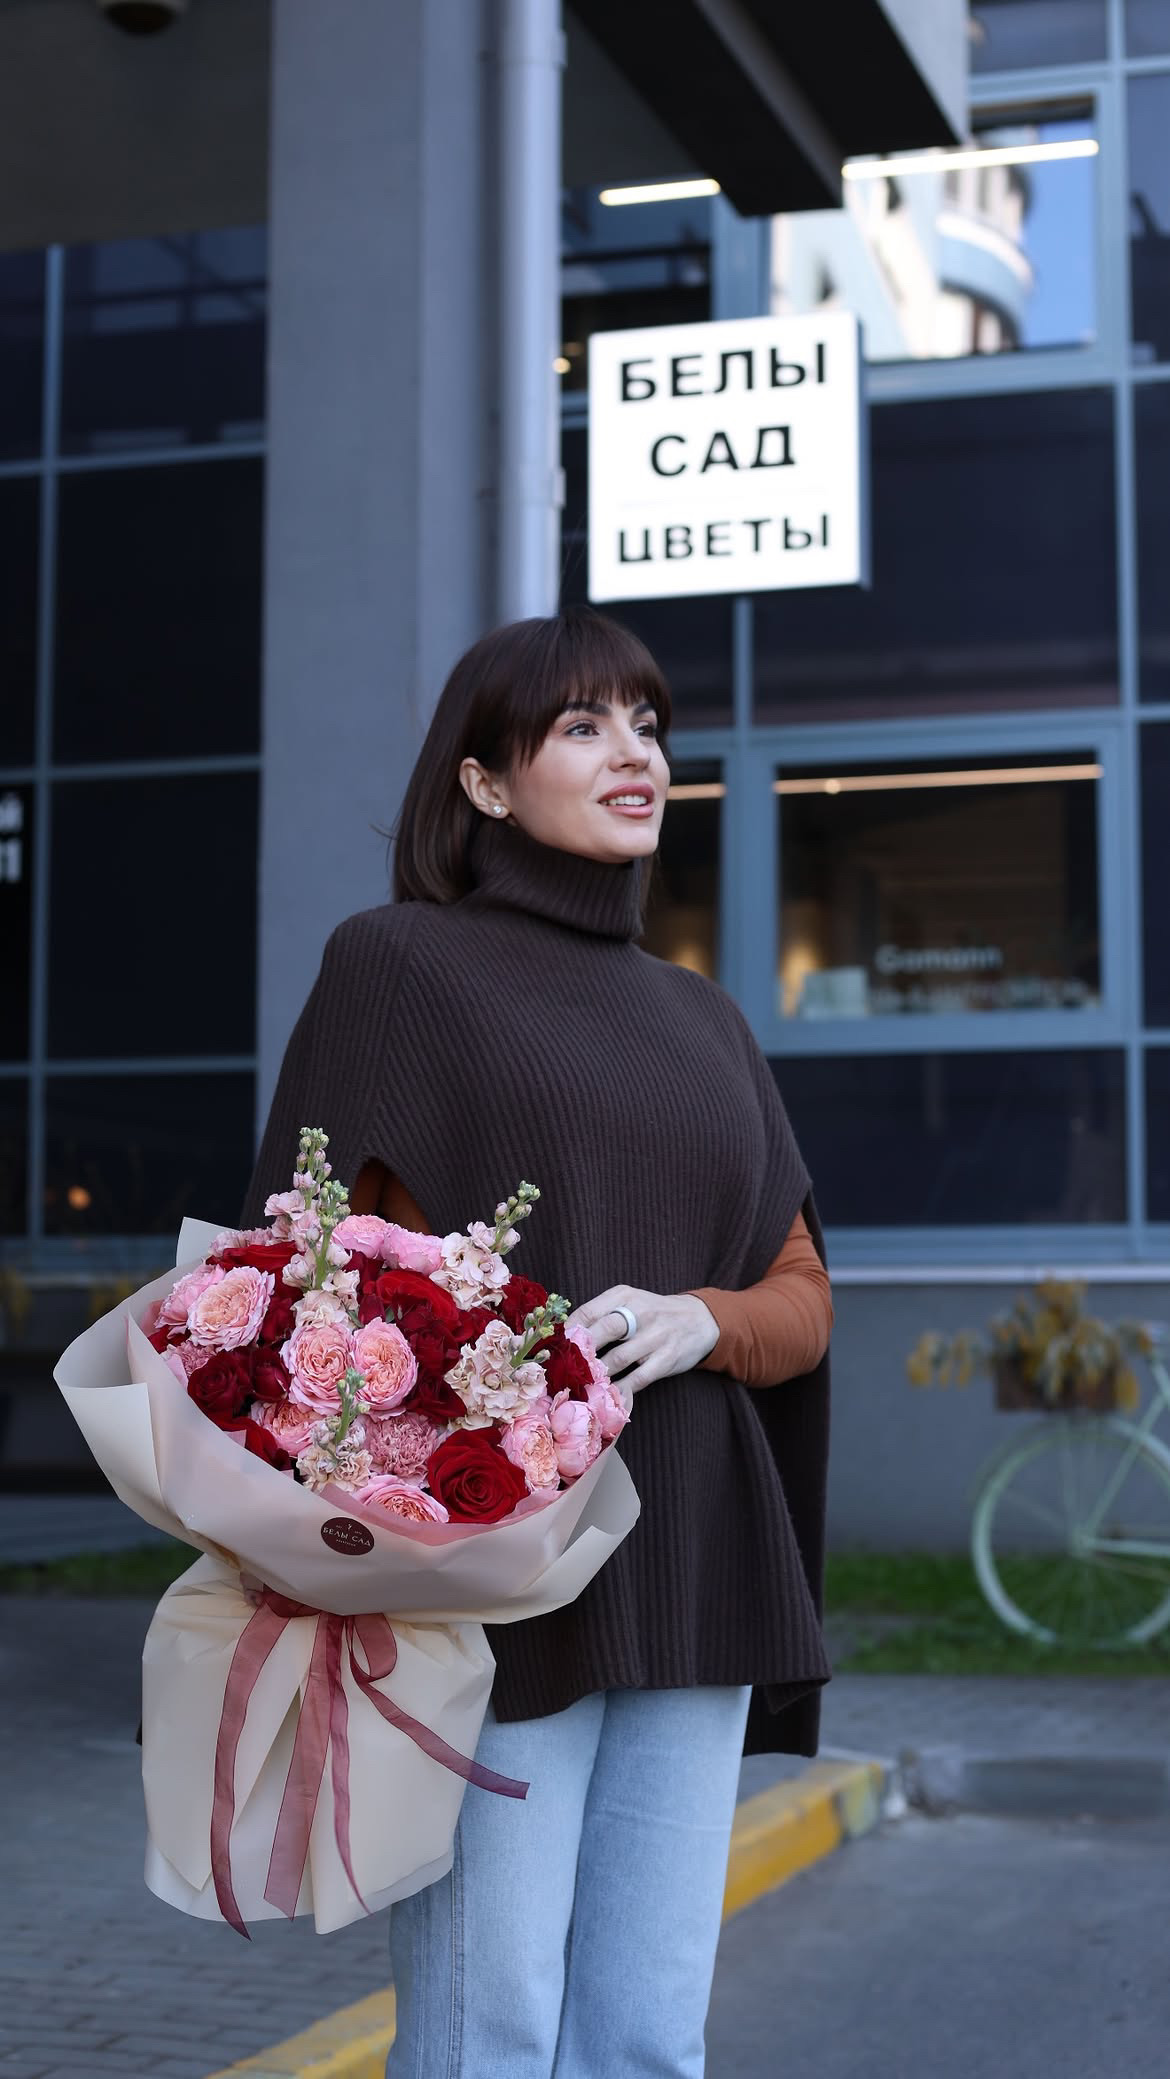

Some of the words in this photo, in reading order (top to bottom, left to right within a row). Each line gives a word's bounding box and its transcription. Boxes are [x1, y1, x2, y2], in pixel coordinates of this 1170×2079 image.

[620, 342, 825, 402] БЕЛЫ
[650, 425, 796, 477] САД
[618, 514, 828, 563] ЦВЕТЫ
